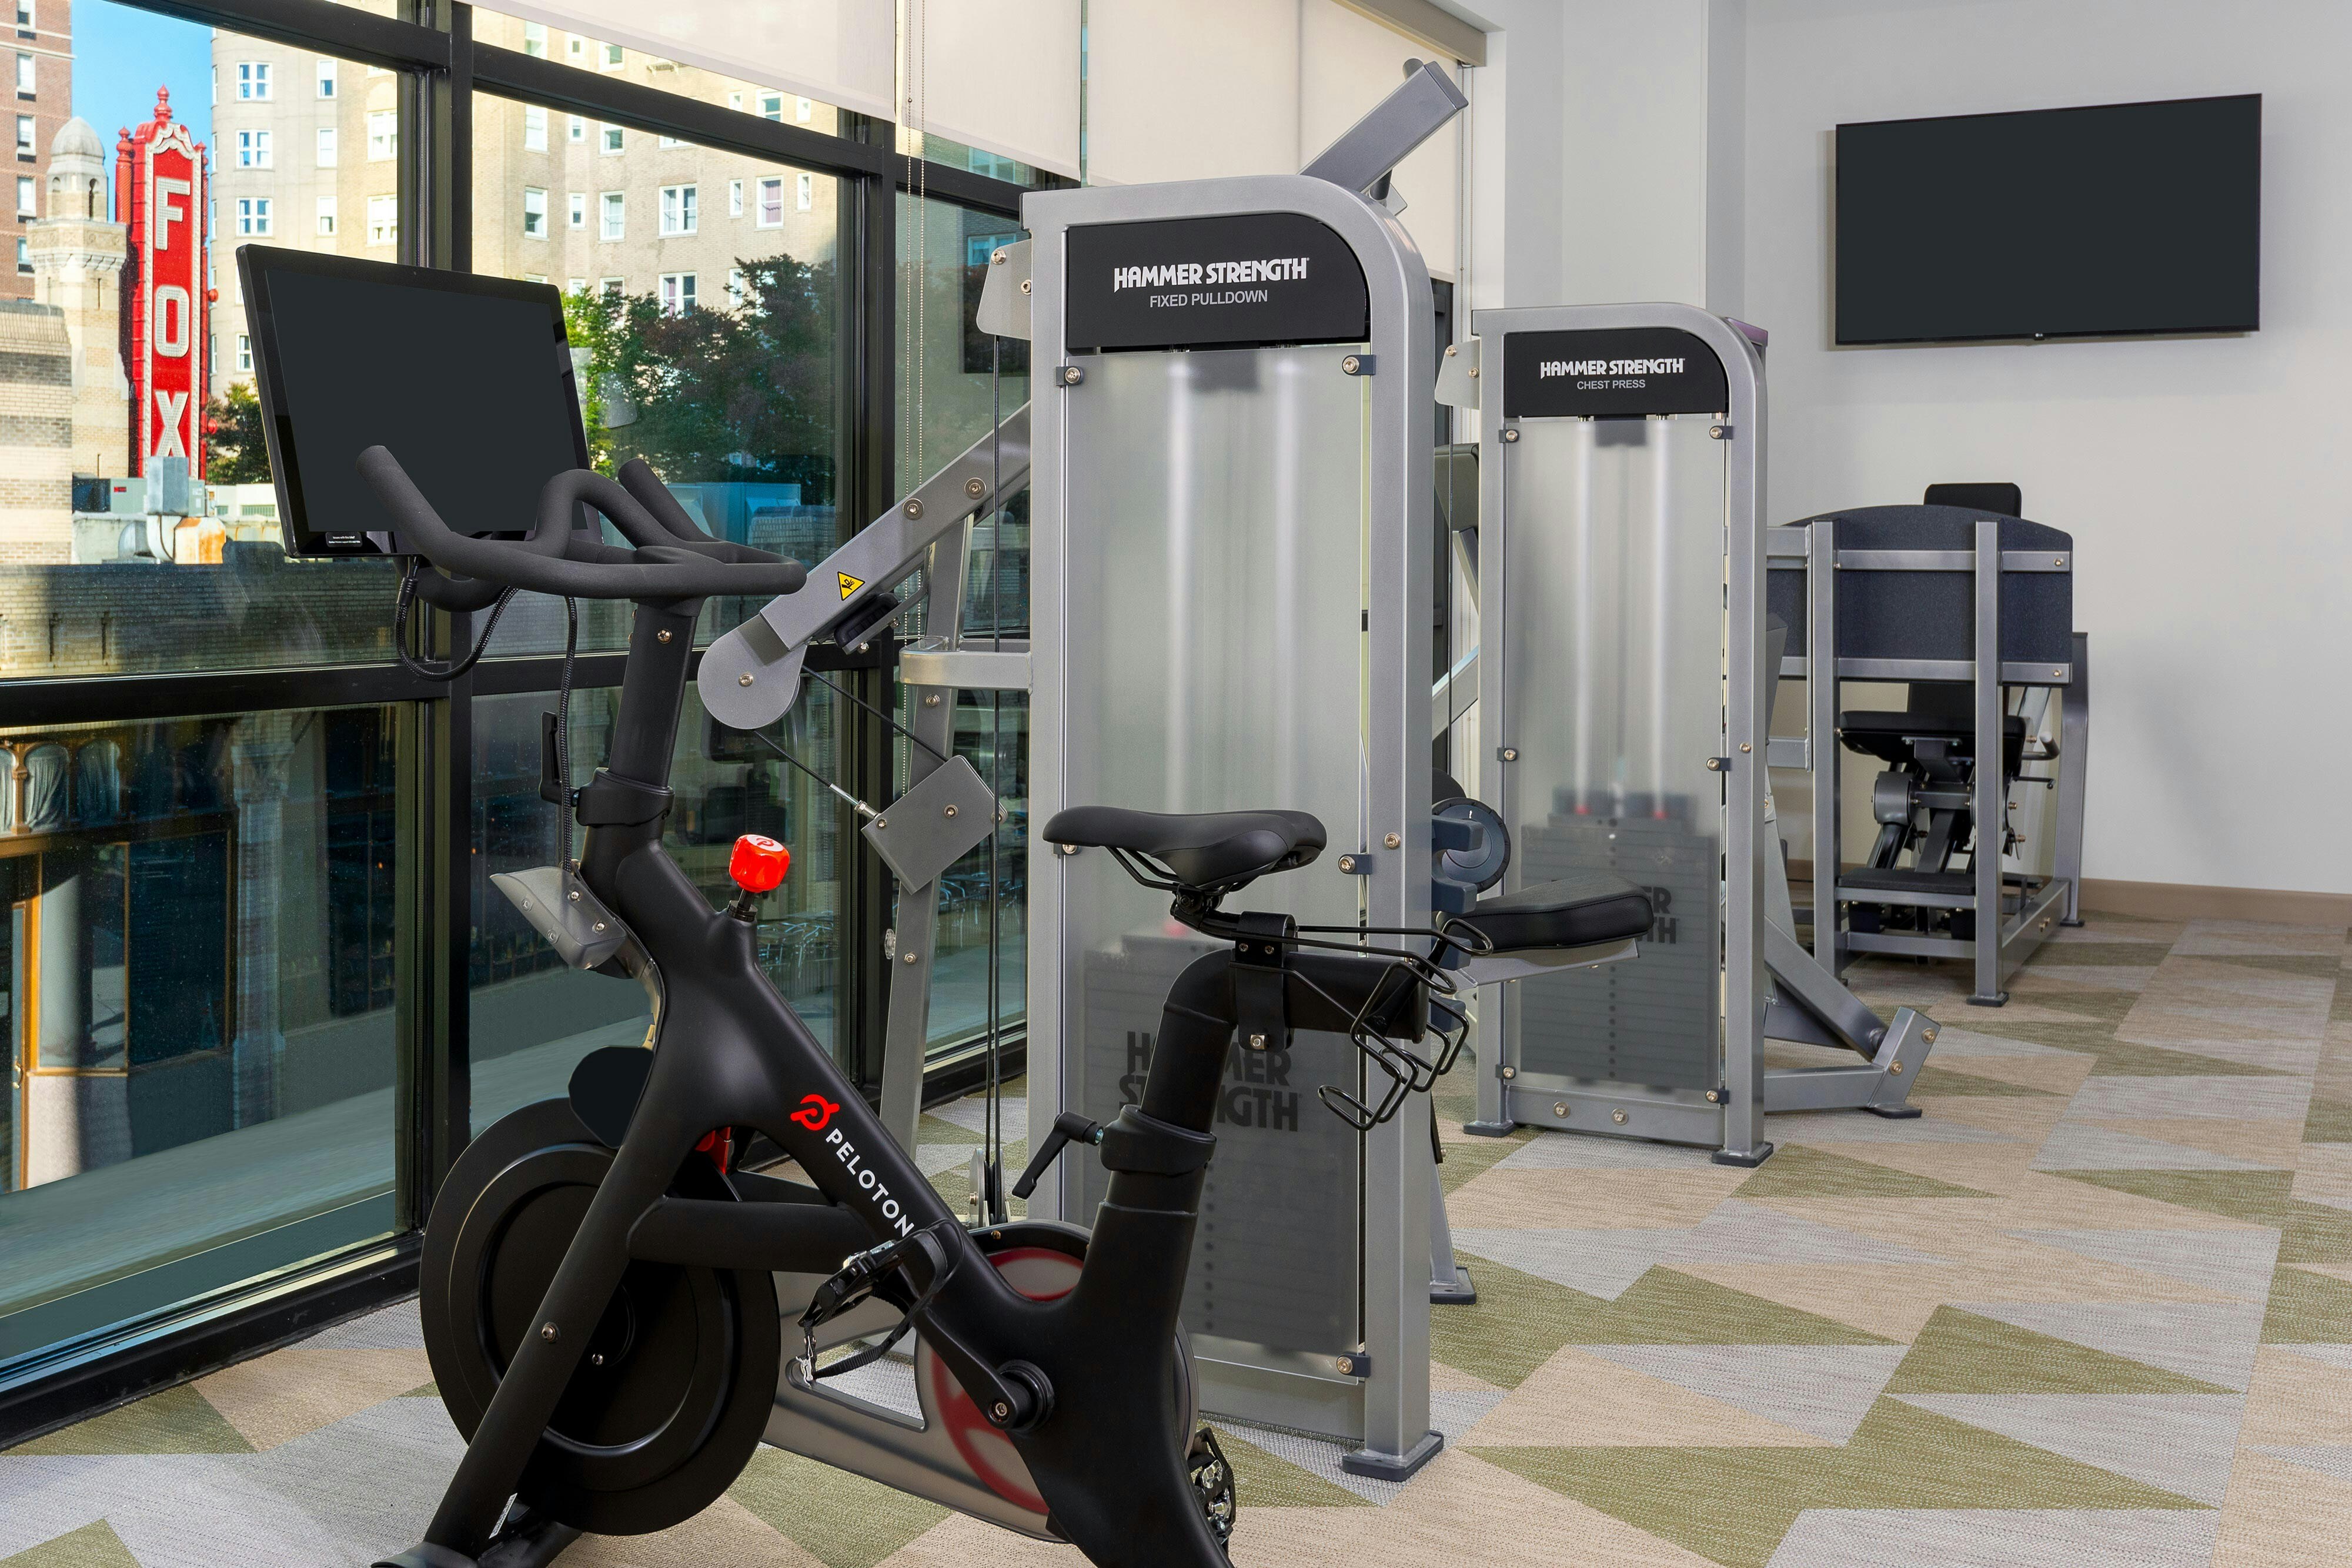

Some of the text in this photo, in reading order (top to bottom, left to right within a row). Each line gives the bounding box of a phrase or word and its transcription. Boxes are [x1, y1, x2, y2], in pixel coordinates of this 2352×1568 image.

[1114, 257, 1307, 293] HAMMER STRENGTH
[155, 178, 191, 457] FOX
[1150, 289, 1268, 307] FIXED PULLDOWN
[1540, 357, 1684, 379] HAMMER STRENGTH
[1576, 379, 1646, 390] CHEST PRESS
[1127, 1031, 1291, 1086] HER
[1118, 1074, 1299, 1132] SGTH
[826, 1128, 914, 1237] PELOTON
